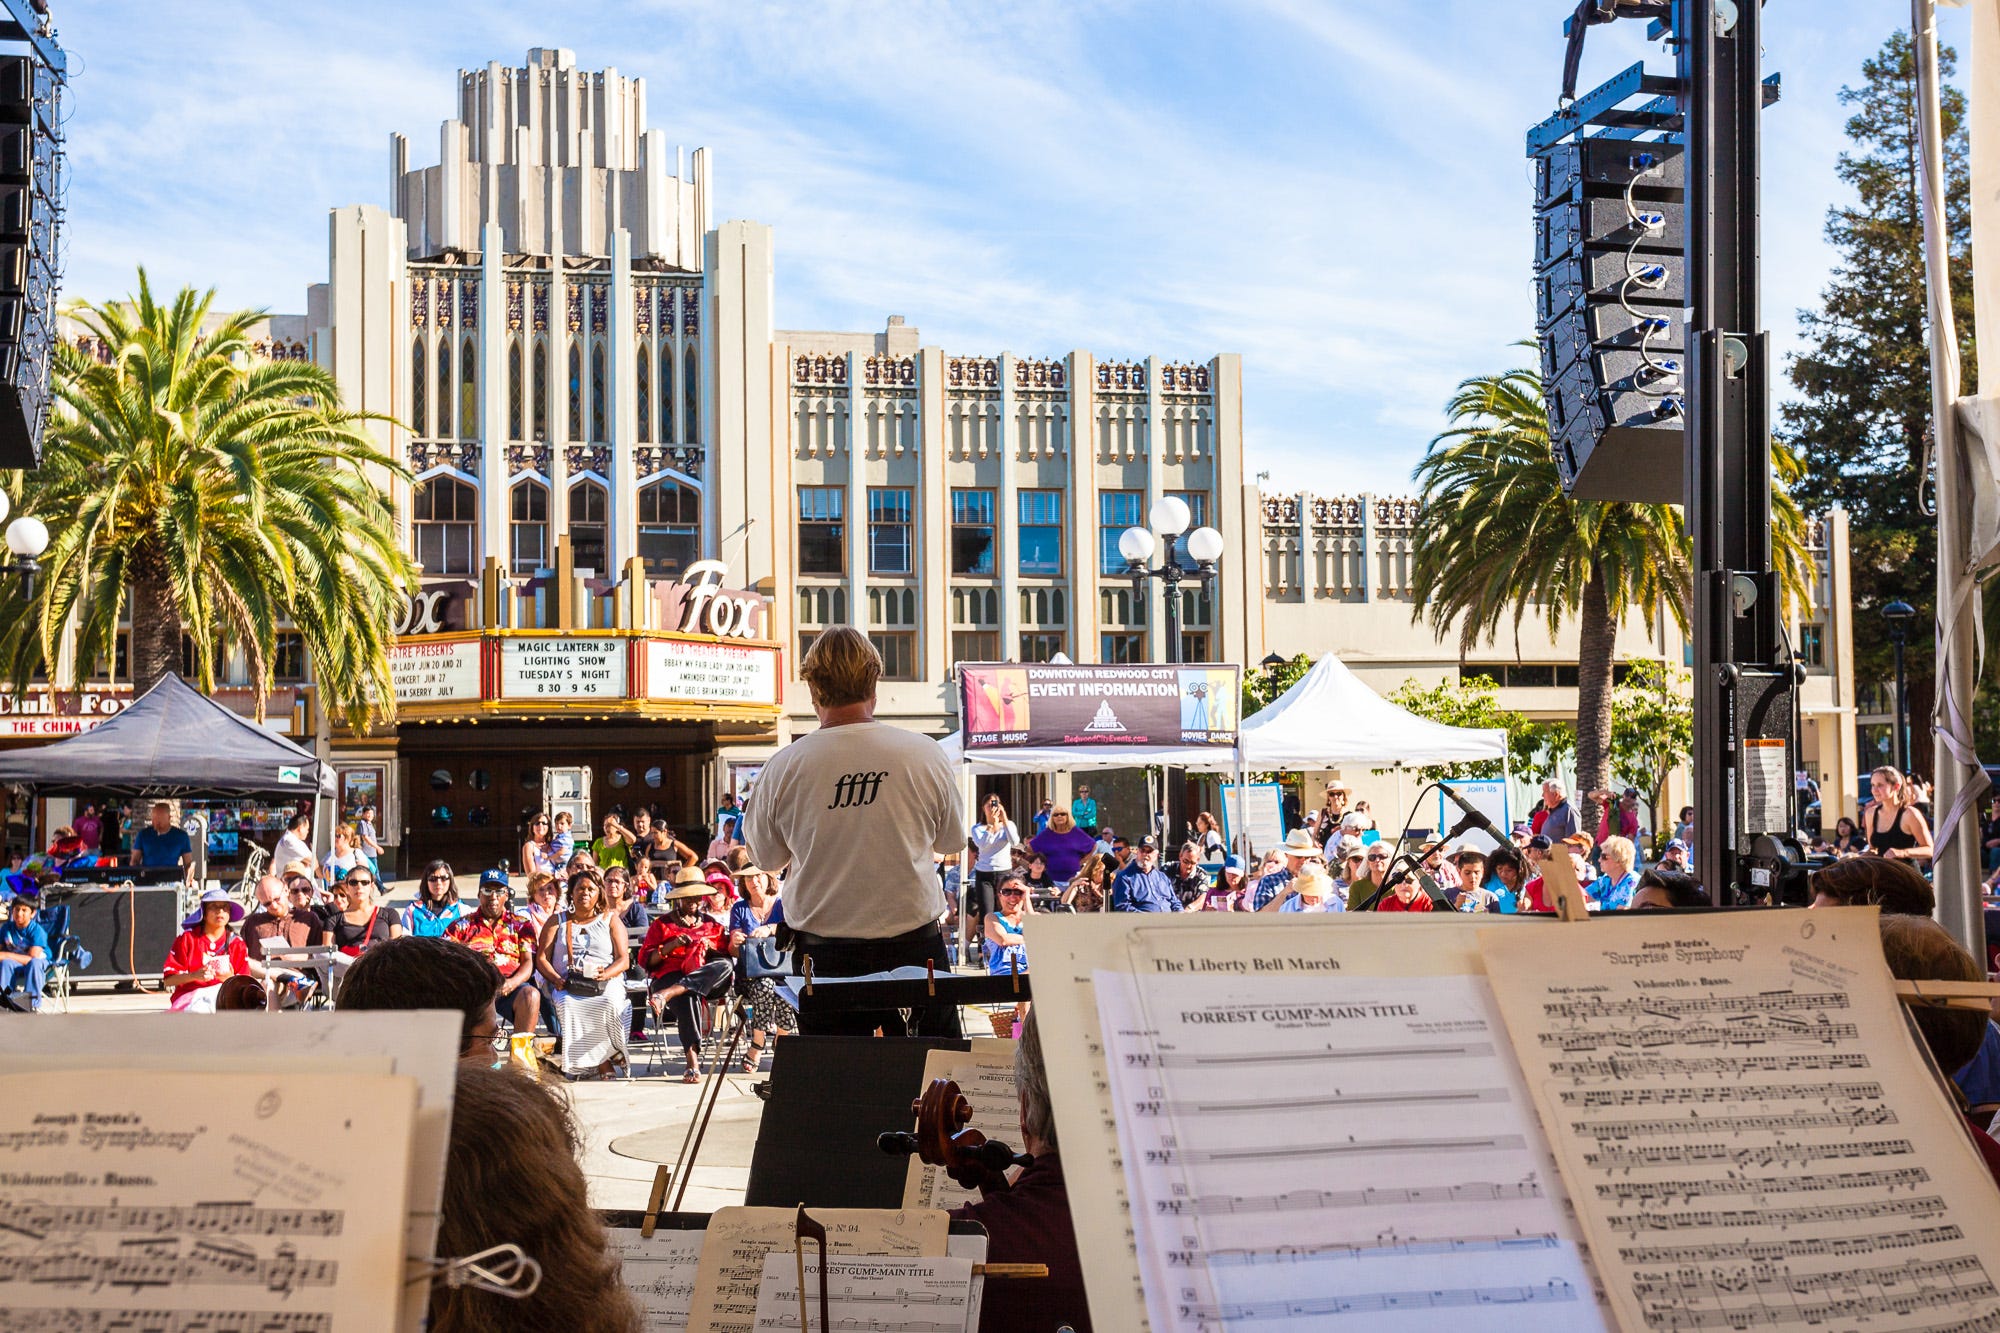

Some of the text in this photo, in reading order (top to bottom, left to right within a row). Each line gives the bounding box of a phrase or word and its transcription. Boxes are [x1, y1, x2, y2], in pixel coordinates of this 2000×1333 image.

[415, 644, 454, 658] PRESENTS
[518, 642, 615, 652] MAGIC LANTERN 3D
[400, 662, 416, 672] LADY
[418, 660, 430, 670] JUN
[432, 660, 440, 669] 20
[441, 659, 454, 669] AND
[524, 656, 606, 666] LIGHTING SHOW
[581, 670, 611, 679] NIGHT
[1028, 669, 1174, 679] DOWNTOWN REDWOOD CITY
[394, 674, 446, 685] CONCERT JUN 27
[409, 688, 432, 697] SKERRY
[437, 687, 454, 696] JULY
[1029, 683, 1179, 697] EVENT INFORMATION
[13, 721, 36, 732] THE
[43, 721, 82, 732] CHINA
[972, 734, 998, 743] STAGE
[1001, 733, 1028, 741] MUSIC
[1181, 731, 1207, 740] MOVIES
[1210, 731, 1233, 740] DANCE
[560, 790, 580, 798] JLG
[1152, 957, 1340, 975] The Liberty Bell March
[1180, 1010, 1257, 1025] FORREST
[1261, 1006, 1367, 1023] GUMP-MAIN
[1370, 1003, 1419, 1017] TITLE
[848, 1266, 907, 1277] GUMP-MAIN
[908, 1268, 935, 1277] TITLE
